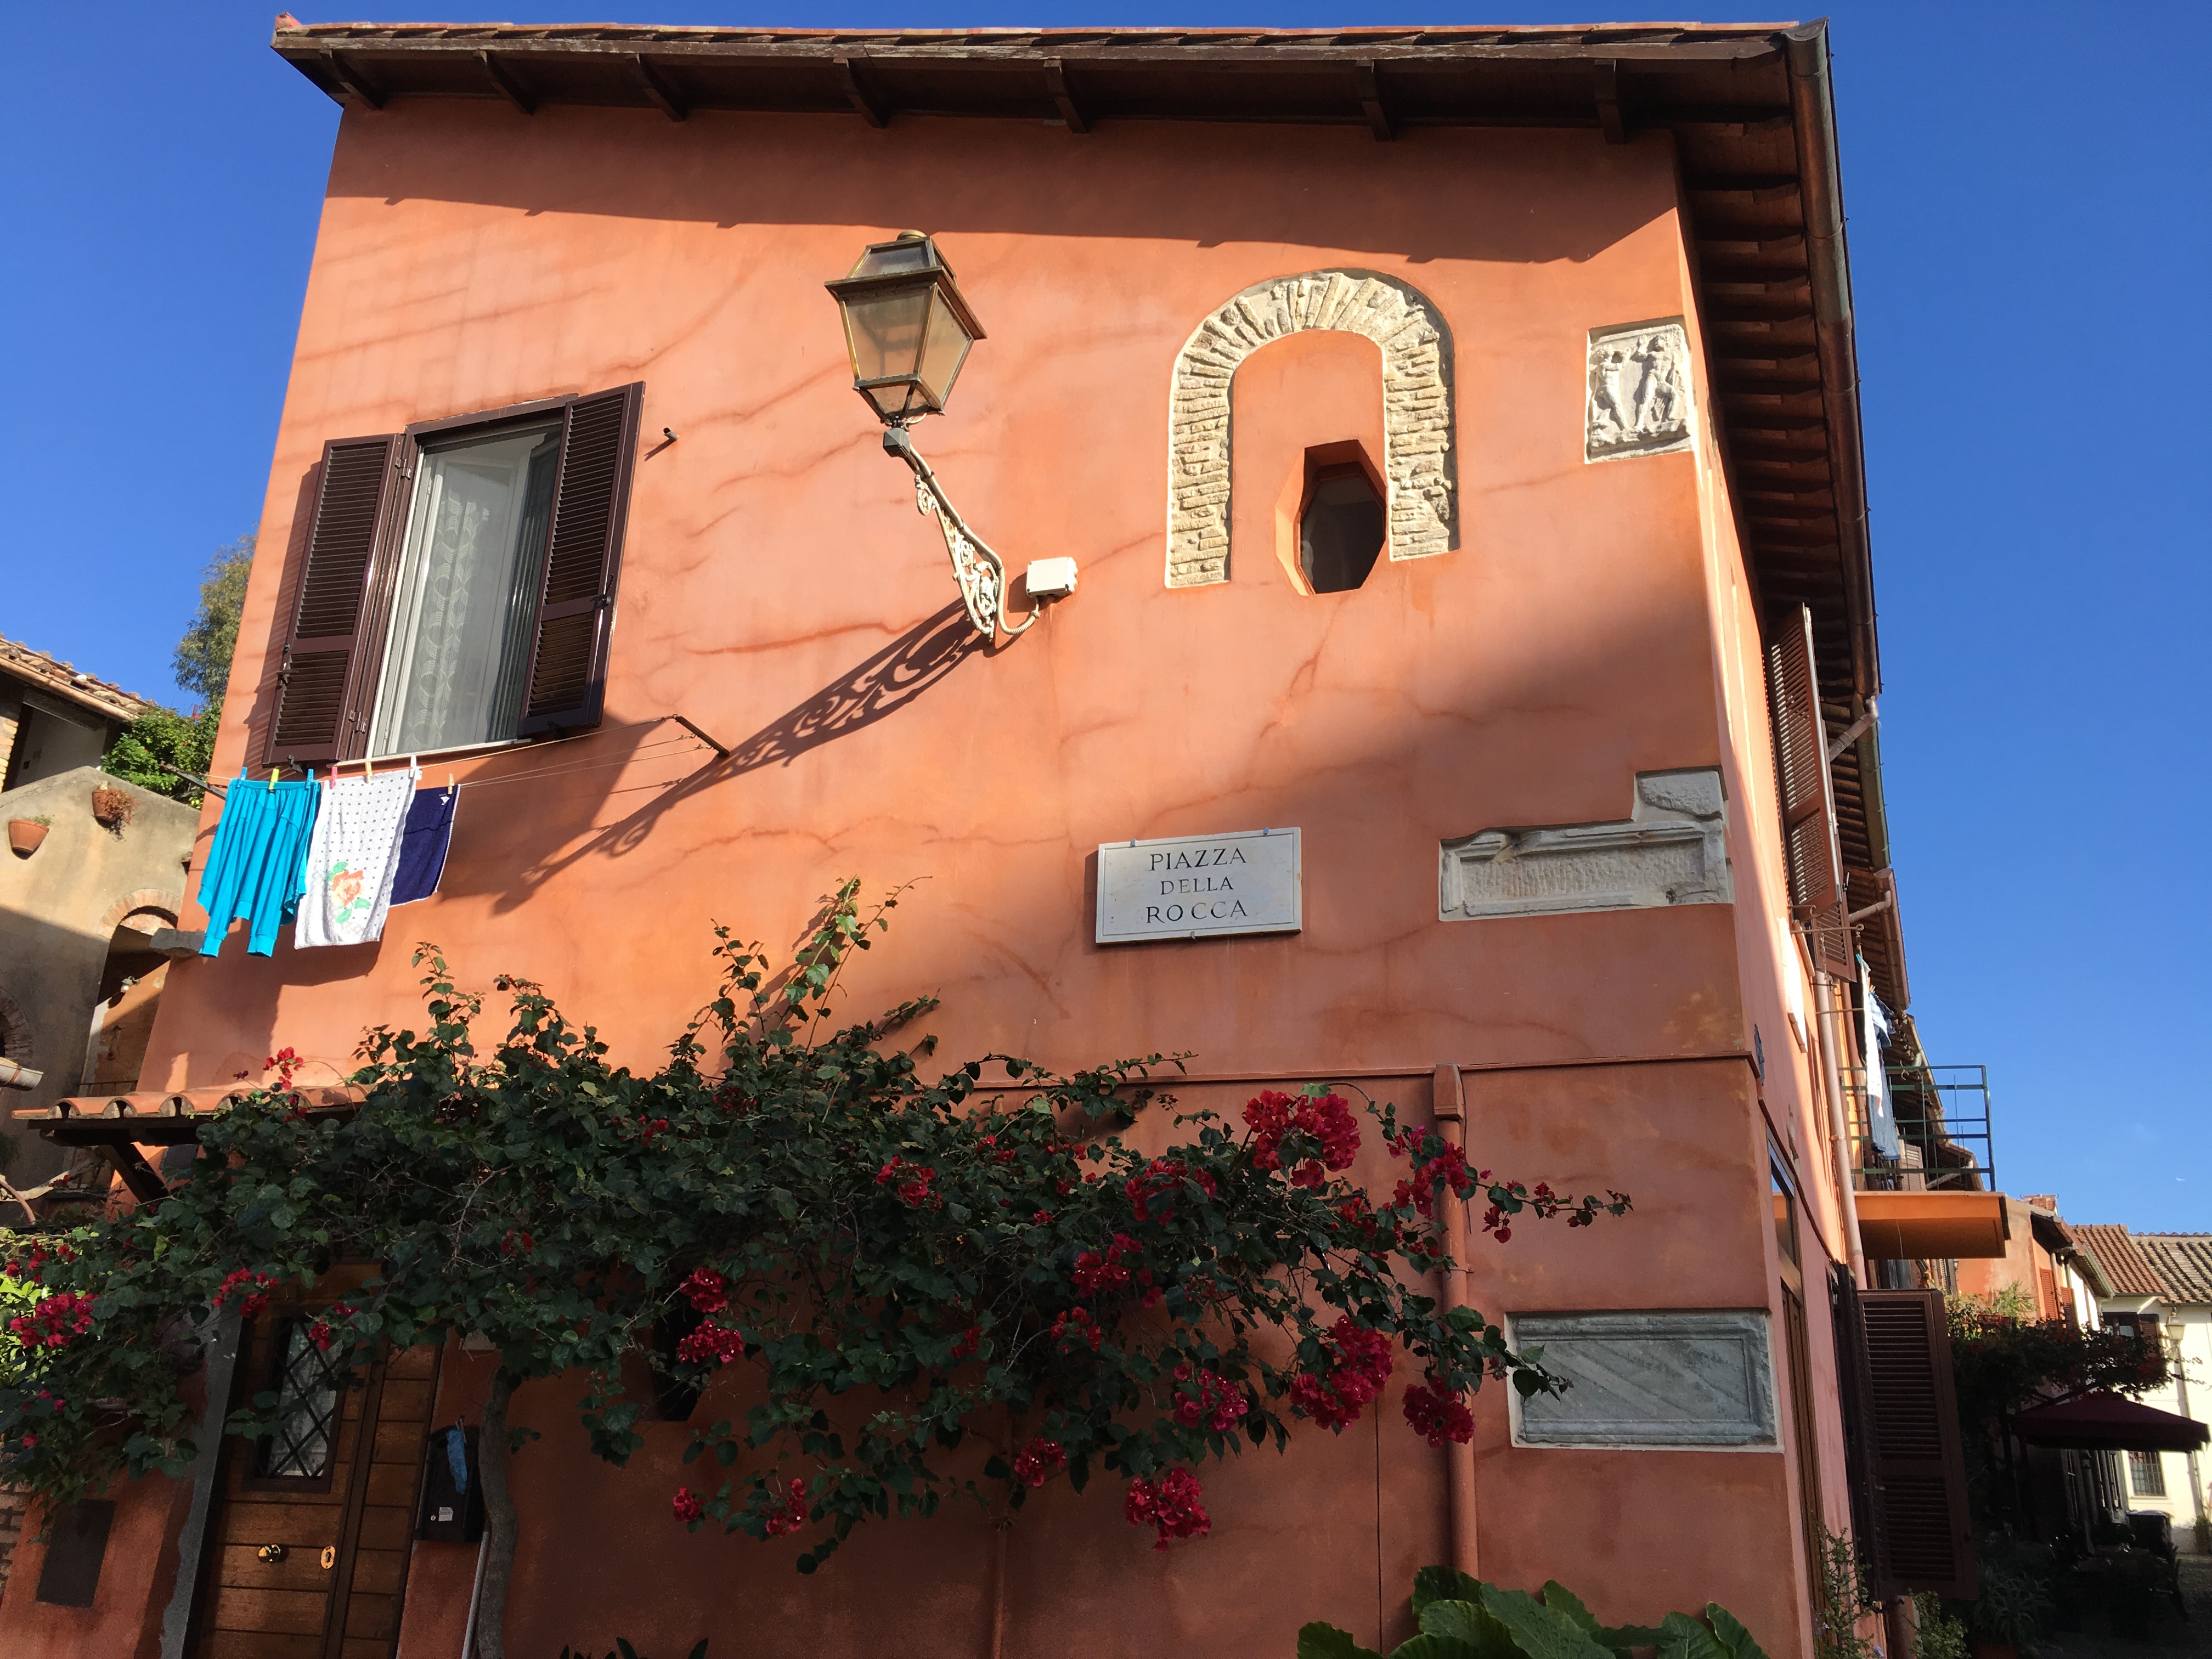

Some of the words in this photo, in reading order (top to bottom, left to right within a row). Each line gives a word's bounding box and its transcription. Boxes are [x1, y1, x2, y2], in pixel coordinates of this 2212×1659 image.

[1150, 848, 1247, 871] PIAZZA
[1160, 876, 1234, 895] DELLA
[1146, 900, 1248, 924] ROCCA
